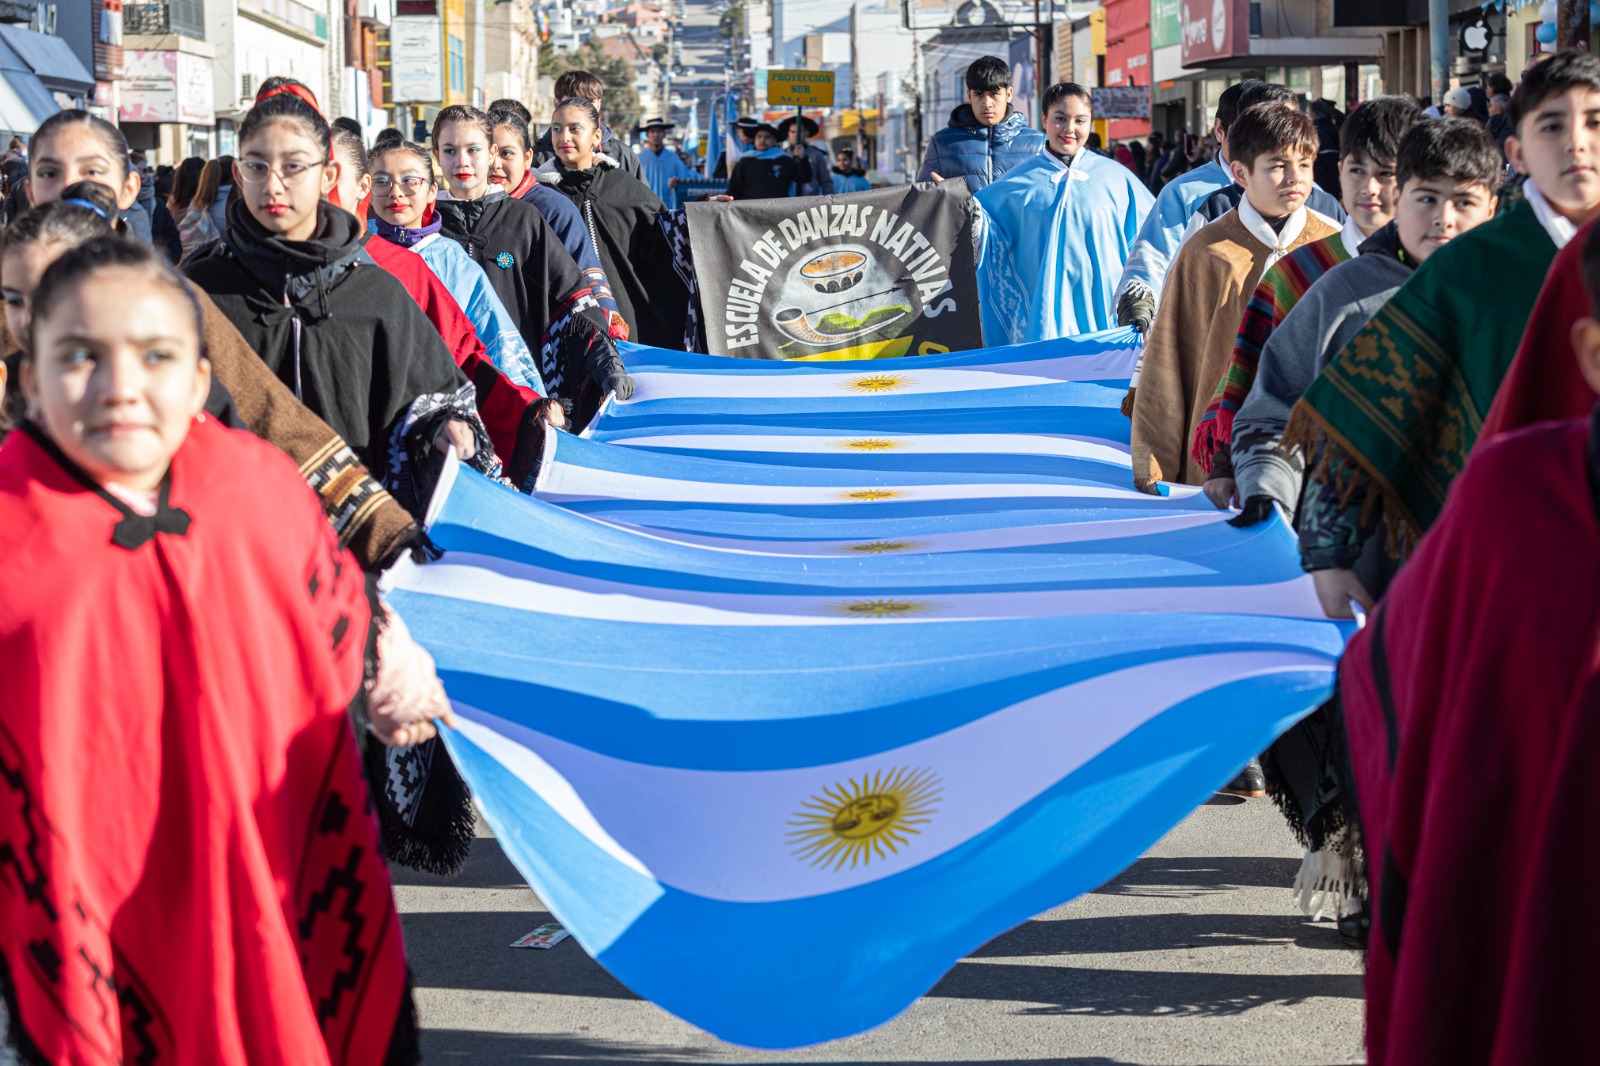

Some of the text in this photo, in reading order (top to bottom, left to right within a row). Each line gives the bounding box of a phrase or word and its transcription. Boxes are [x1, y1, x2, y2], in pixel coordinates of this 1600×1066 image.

[771, 73, 832, 83] PROYECCION
[790, 85, 811, 93] SUR
[725, 204, 957, 350] ESCUELA DE DANZAS NATIVAS
